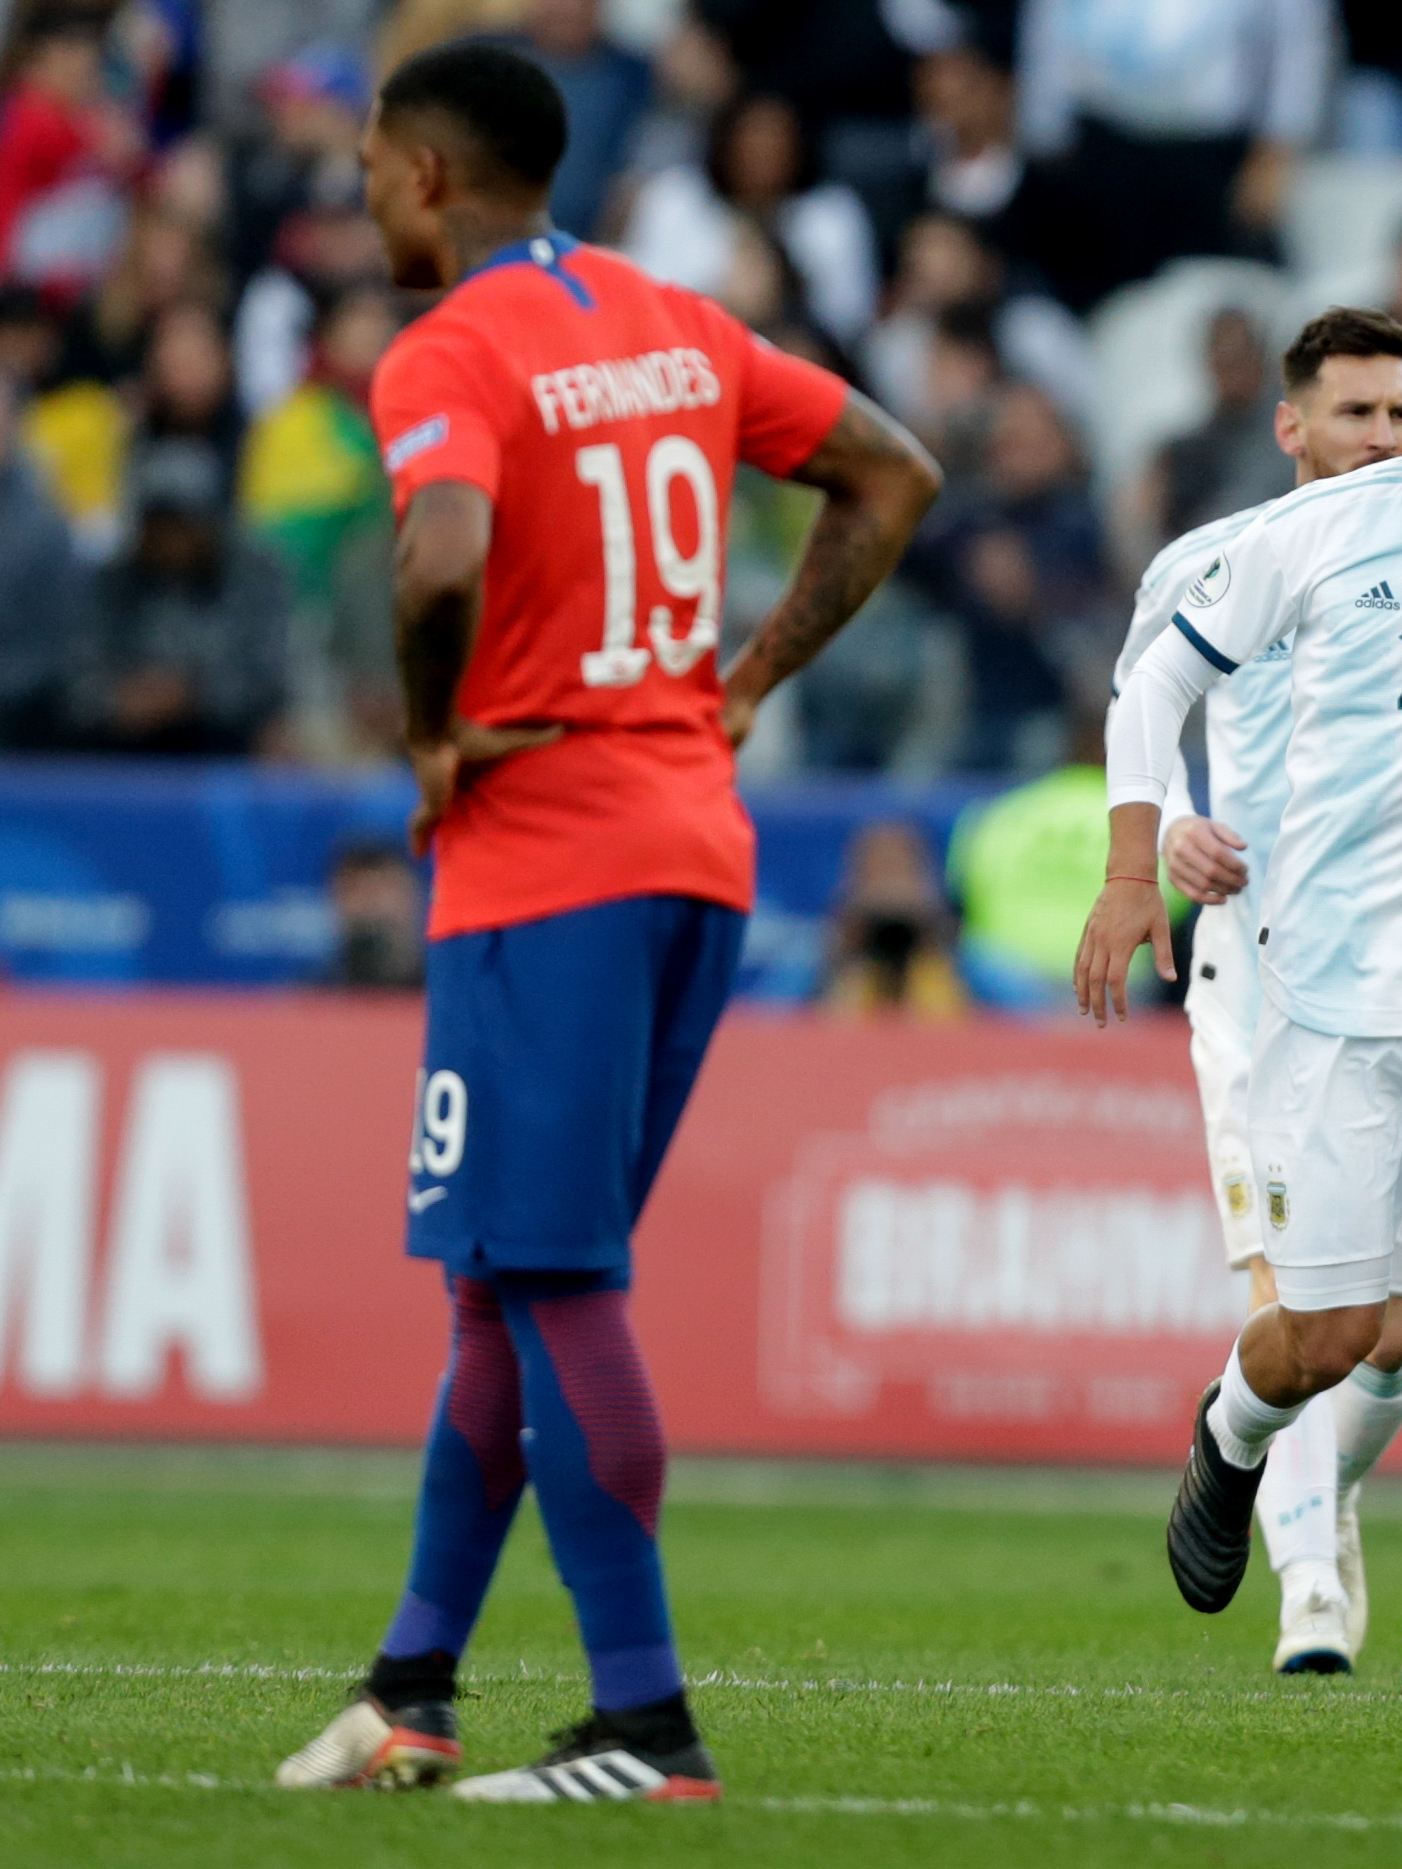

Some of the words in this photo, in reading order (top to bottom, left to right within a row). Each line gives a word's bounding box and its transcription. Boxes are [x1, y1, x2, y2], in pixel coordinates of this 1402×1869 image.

[531, 347, 721, 434] FERNANDES
[576, 435, 719, 688] 19
[1355, 598, 1401, 611] adidas
